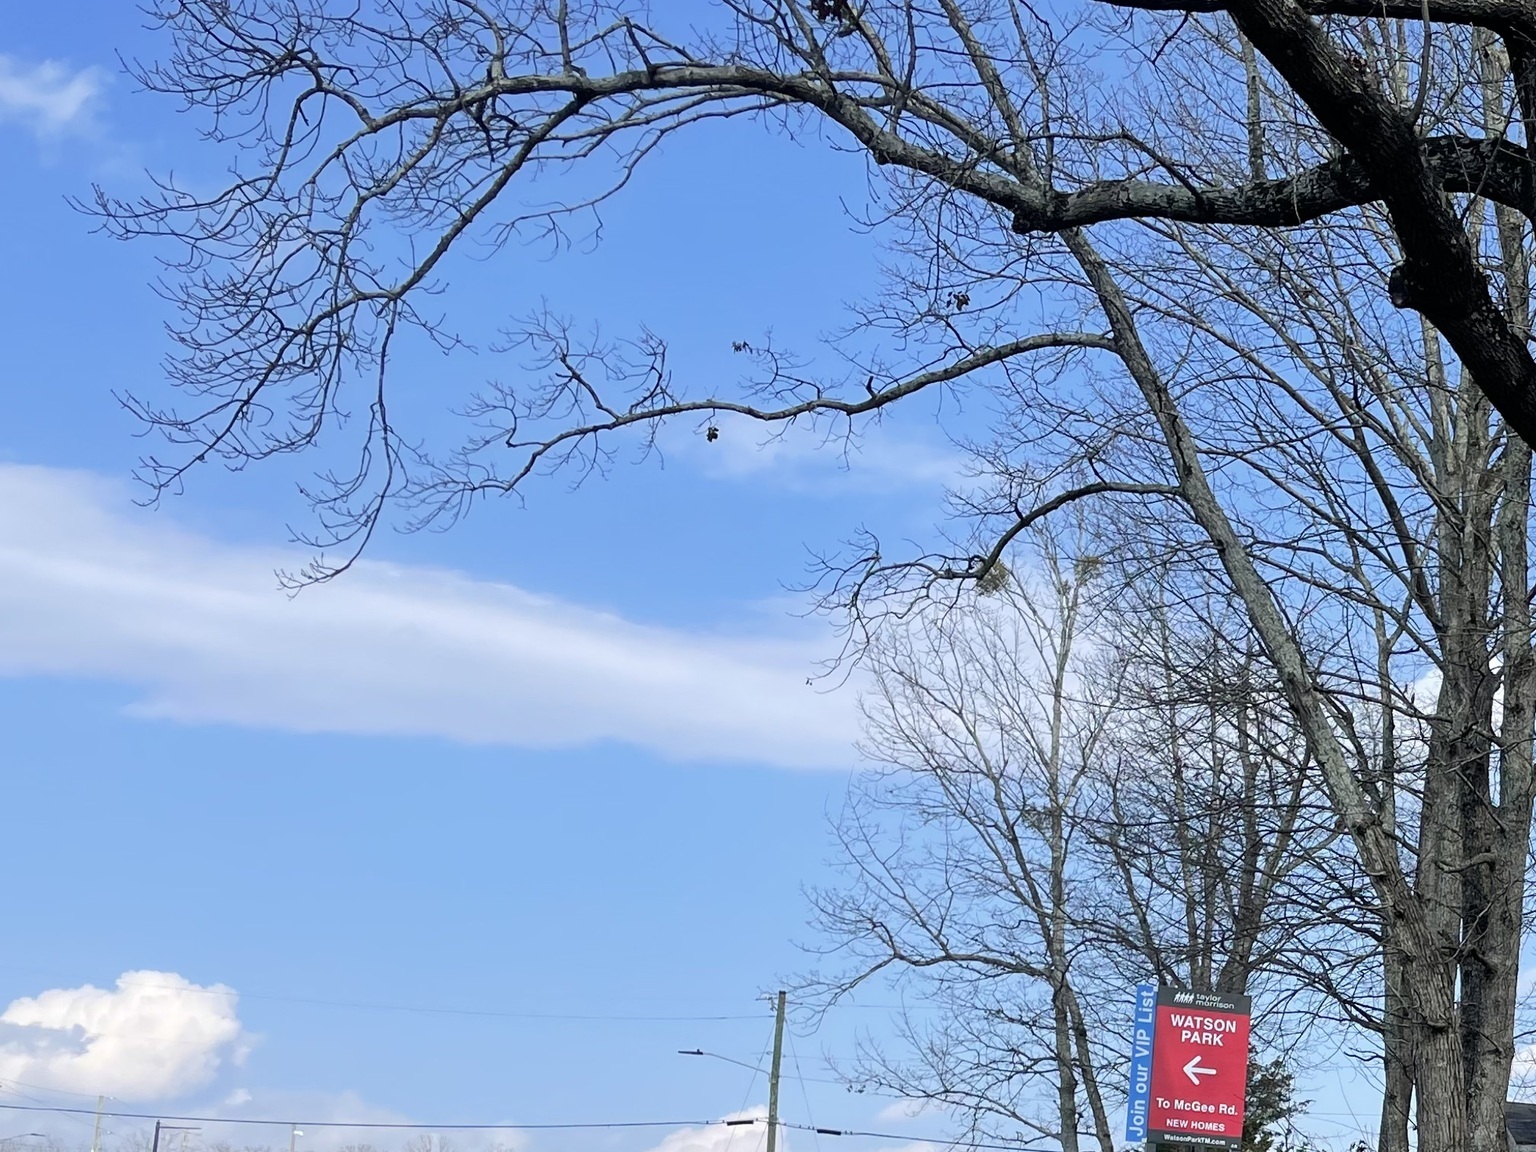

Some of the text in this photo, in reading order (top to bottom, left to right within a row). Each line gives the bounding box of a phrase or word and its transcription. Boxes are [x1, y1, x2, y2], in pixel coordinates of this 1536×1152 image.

[1195, 1000, 1235, 1009] morrison
[1196, 993, 1221, 1002] taylor
[1171, 1013, 1237, 1033] WATSON
[1181, 1030, 1224, 1046] PARK
[1129, 990, 1154, 1136] Join our VIP List
[1156, 1097, 1238, 1115] To McGee Rd.
[1166, 1118, 1226, 1132] NEW HOMES
[1164, 1134, 1226, 1145] WatsonParkTM.com
